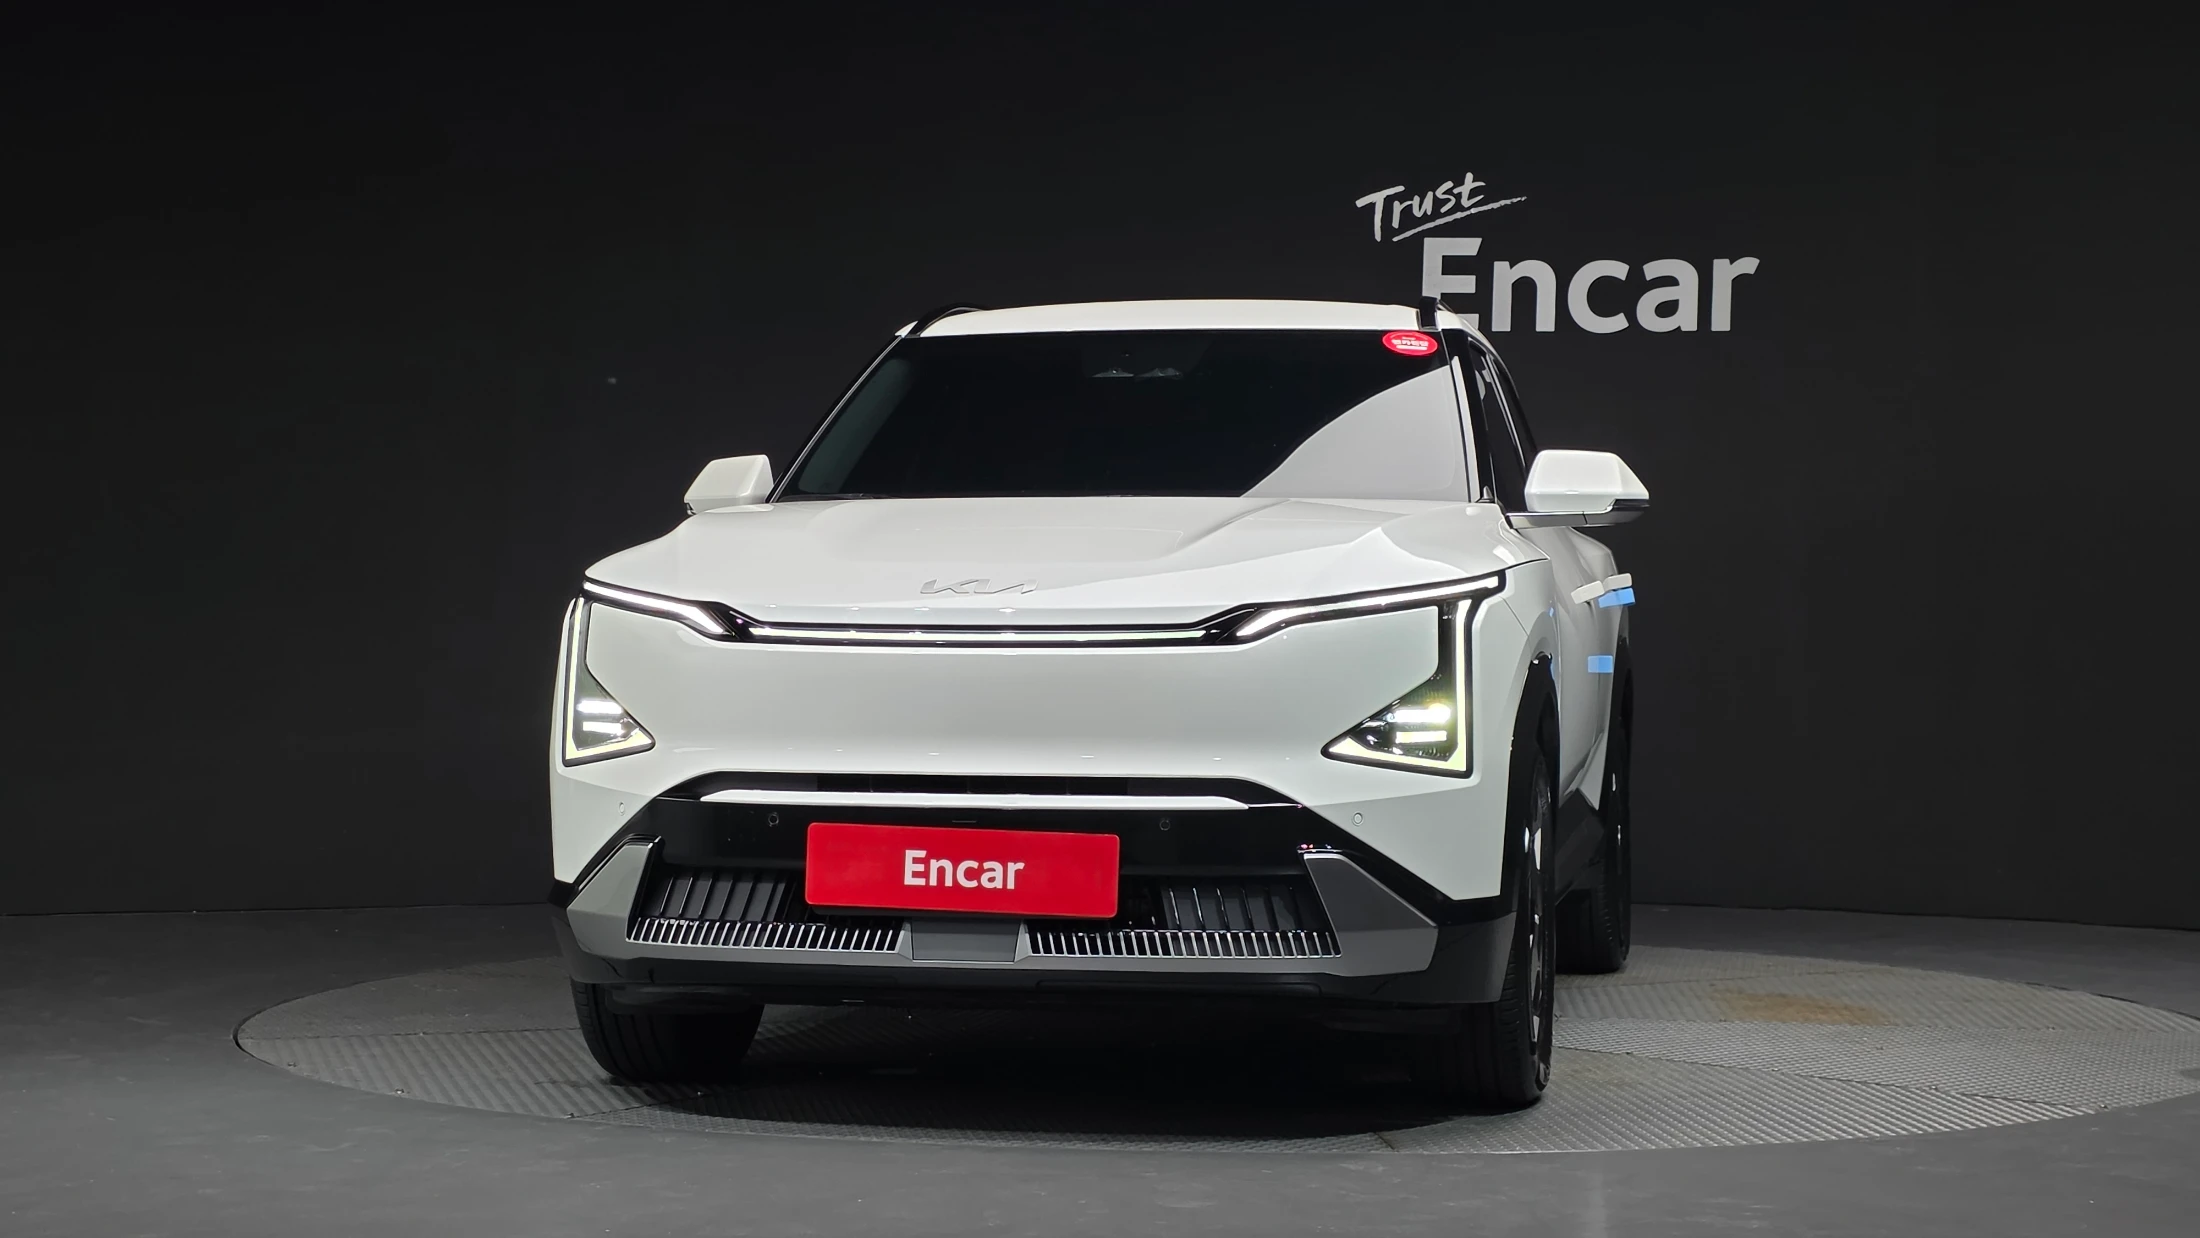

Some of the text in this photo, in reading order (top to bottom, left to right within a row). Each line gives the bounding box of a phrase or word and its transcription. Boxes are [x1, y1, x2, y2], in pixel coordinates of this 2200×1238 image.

[1356, 172, 1486, 242] Trust
[1422, 237, 1760, 334] Encar
[920, 578, 1039, 595] KIA
[903, 850, 1025, 889] Encar
